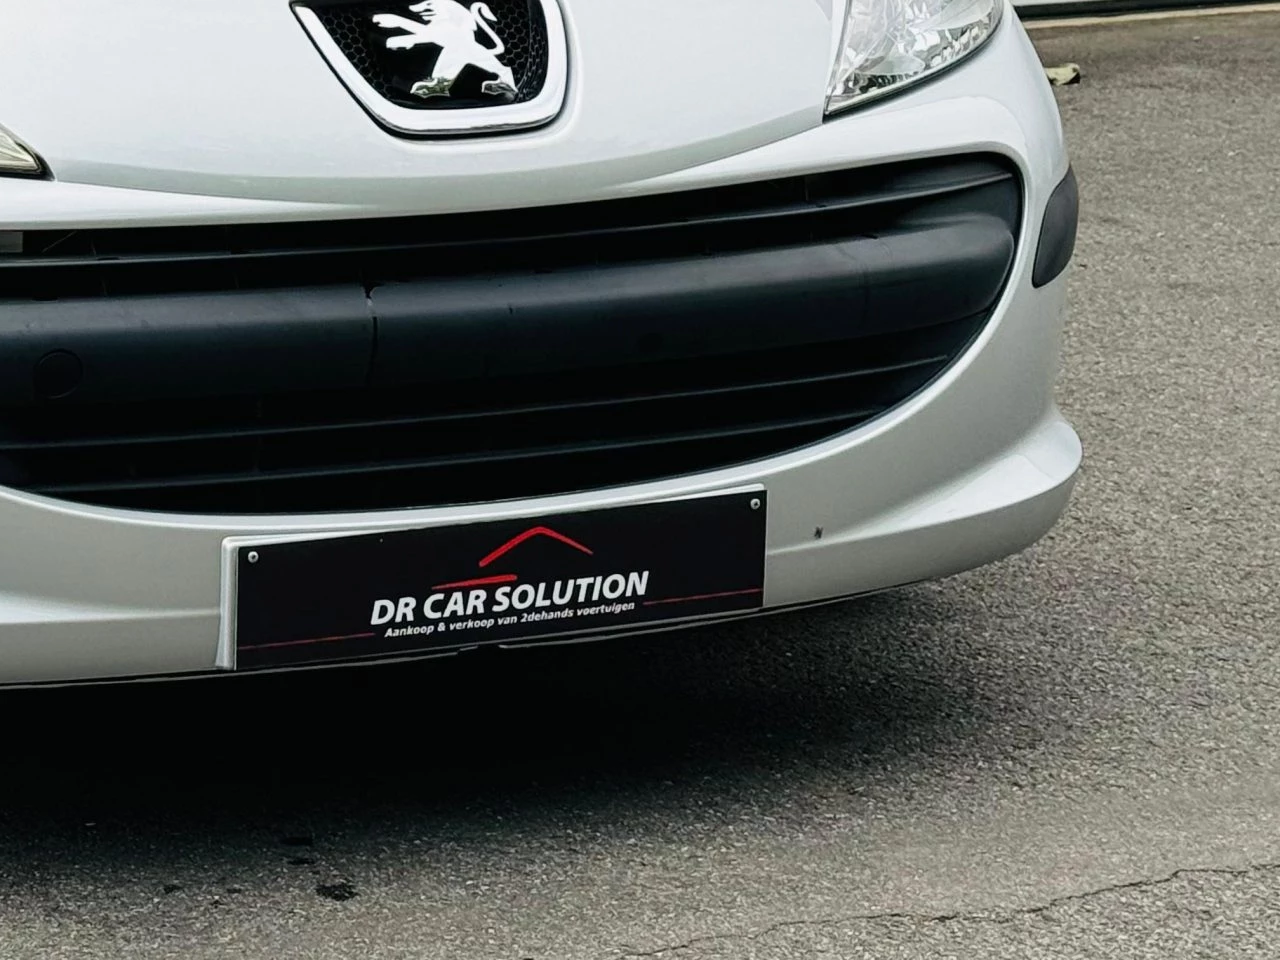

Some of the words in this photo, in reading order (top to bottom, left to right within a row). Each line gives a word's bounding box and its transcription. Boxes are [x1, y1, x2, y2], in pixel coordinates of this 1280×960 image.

[370, 596, 417, 625] DR
[423, 589, 487, 619] CAR
[491, 570, 649, 612] SOLUTION
[384, 625, 434, 638] Aankoop
[437, 622, 446, 632] &
[449, 618, 494, 630] verkoop
[497, 616, 518, 625] van
[520, 608, 574, 623] 2dehands
[576, 602, 635, 616] voertuigen
